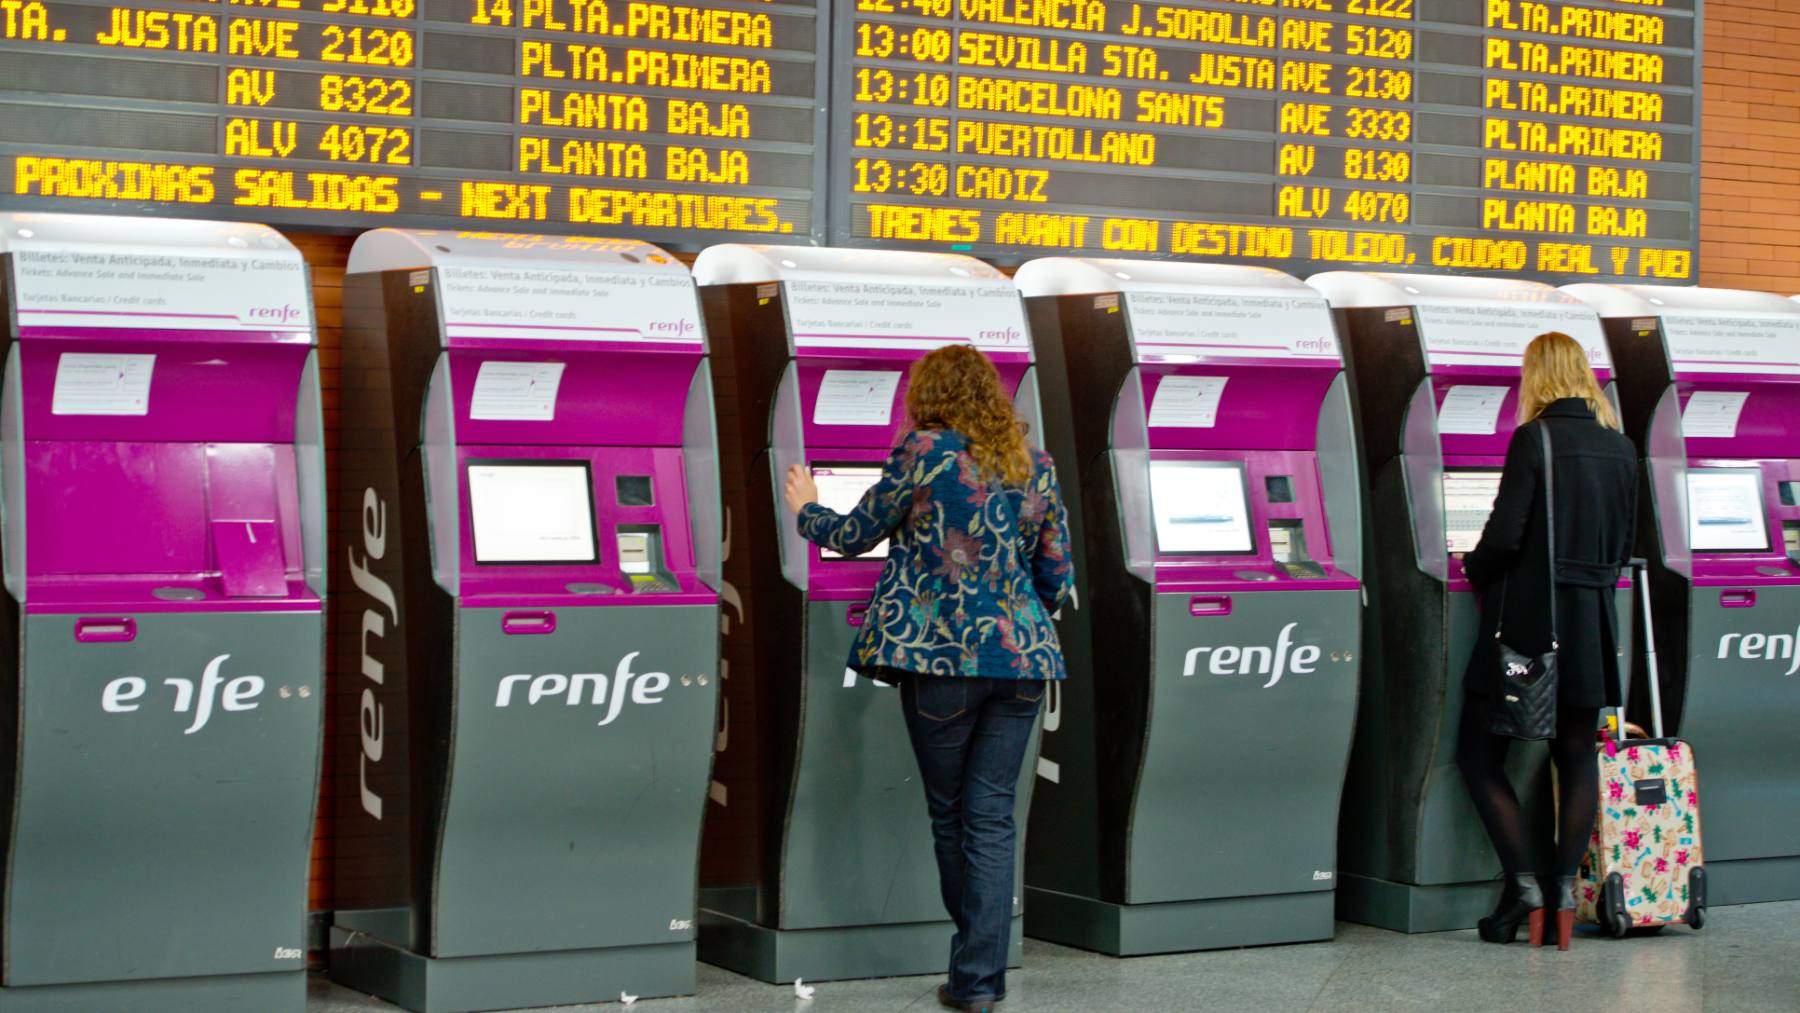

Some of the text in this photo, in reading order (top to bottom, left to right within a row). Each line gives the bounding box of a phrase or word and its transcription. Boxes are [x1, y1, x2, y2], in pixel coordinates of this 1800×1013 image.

[96, 8, 217, 52] JUSTA
[229, 18, 299, 58] AVE
[321, 25, 413, 68] 2120
[522, 42, 771, 93] PLTA.PRIMERA
[523, 0, 772, 48] PLTA.PRIMERA
[1121, 4, 1276, 48] J.SOROLLA
[1282, 19, 1333, 52] AVE
[1347, 25, 1412, 59] 5120
[1486, 38, 1663, 83] PLTA.PRIMERA
[1487, 0, 1664, 44] PLTA.PRIMERA
[227, 69, 750, 138] AV 8322 PLANTA BAJA
[857, 24, 1663, 122] 13:00 SEVILLA STA. JUSTA AVE 2130 PLTA.PRIMERA
[856, 69, 1662, 160] 13:10 BARCELONA SANTS AVE 3333 PLTA.PRIMERA
[225, 119, 749, 185] ALV 4072 PLANTA BAJA
[855, 113, 1648, 198] 13:15 PUERTOLLANO AV 8130 PLANTA BAJA
[15, 156, 215, 203] PROXIMAS
[234, 169, 399, 213] SALIDAS
[461, 180, 551, 220] NEXT
[569, 186, 793, 233] DEPARTURES.
[854, 158, 1647, 238] 13:30 CADIZ ALV 4070 PLANTA BAJA
[20, 252, 68, 263] Billetes:
[72, 253, 104, 264] Venta
[109, 255, 175, 268] Anticipada,
[179, 258, 238, 268] Inmediata
[251, 260, 299, 270] Cambios
[866, 204, 981, 242] TRENES
[995, 212, 1089, 248] AVANT
[1101, 218, 1159, 252] CON
[1171, 222, 1293, 258] DESTINO
[1307, 229, 1416, 264] TOLEDO,
[1432, 236, 1527, 269] CIUDAD
[1537, 242, 1599, 274] REAL
[1611, 247, 1630, 275] Y
[444, 268, 488, 279] Billetes:
[490, 270, 520, 280] Venta
[524, 272, 582, 284] Anticipada,
[585, 274, 636, 284] Inmediata
[648, 276, 690, 287] Cambios
[791, 282, 831, 292] Billetes:
[833, 284, 860, 293] Venta
[864, 284, 916, 296] Anticipada,
[920, 286, 966, 296] Inmediata
[977, 288, 1016, 298] Cambios
[249, 304, 300, 322] renfe
[650, 318, 694, 336] renfe
[979, 327, 1020, 345] renfe
[1295, 336, 1332, 353] renfe
[350, 487, 398, 820] renfe
[1184, 622, 1321, 689] renfe
[495, 651, 670, 726] renfe
